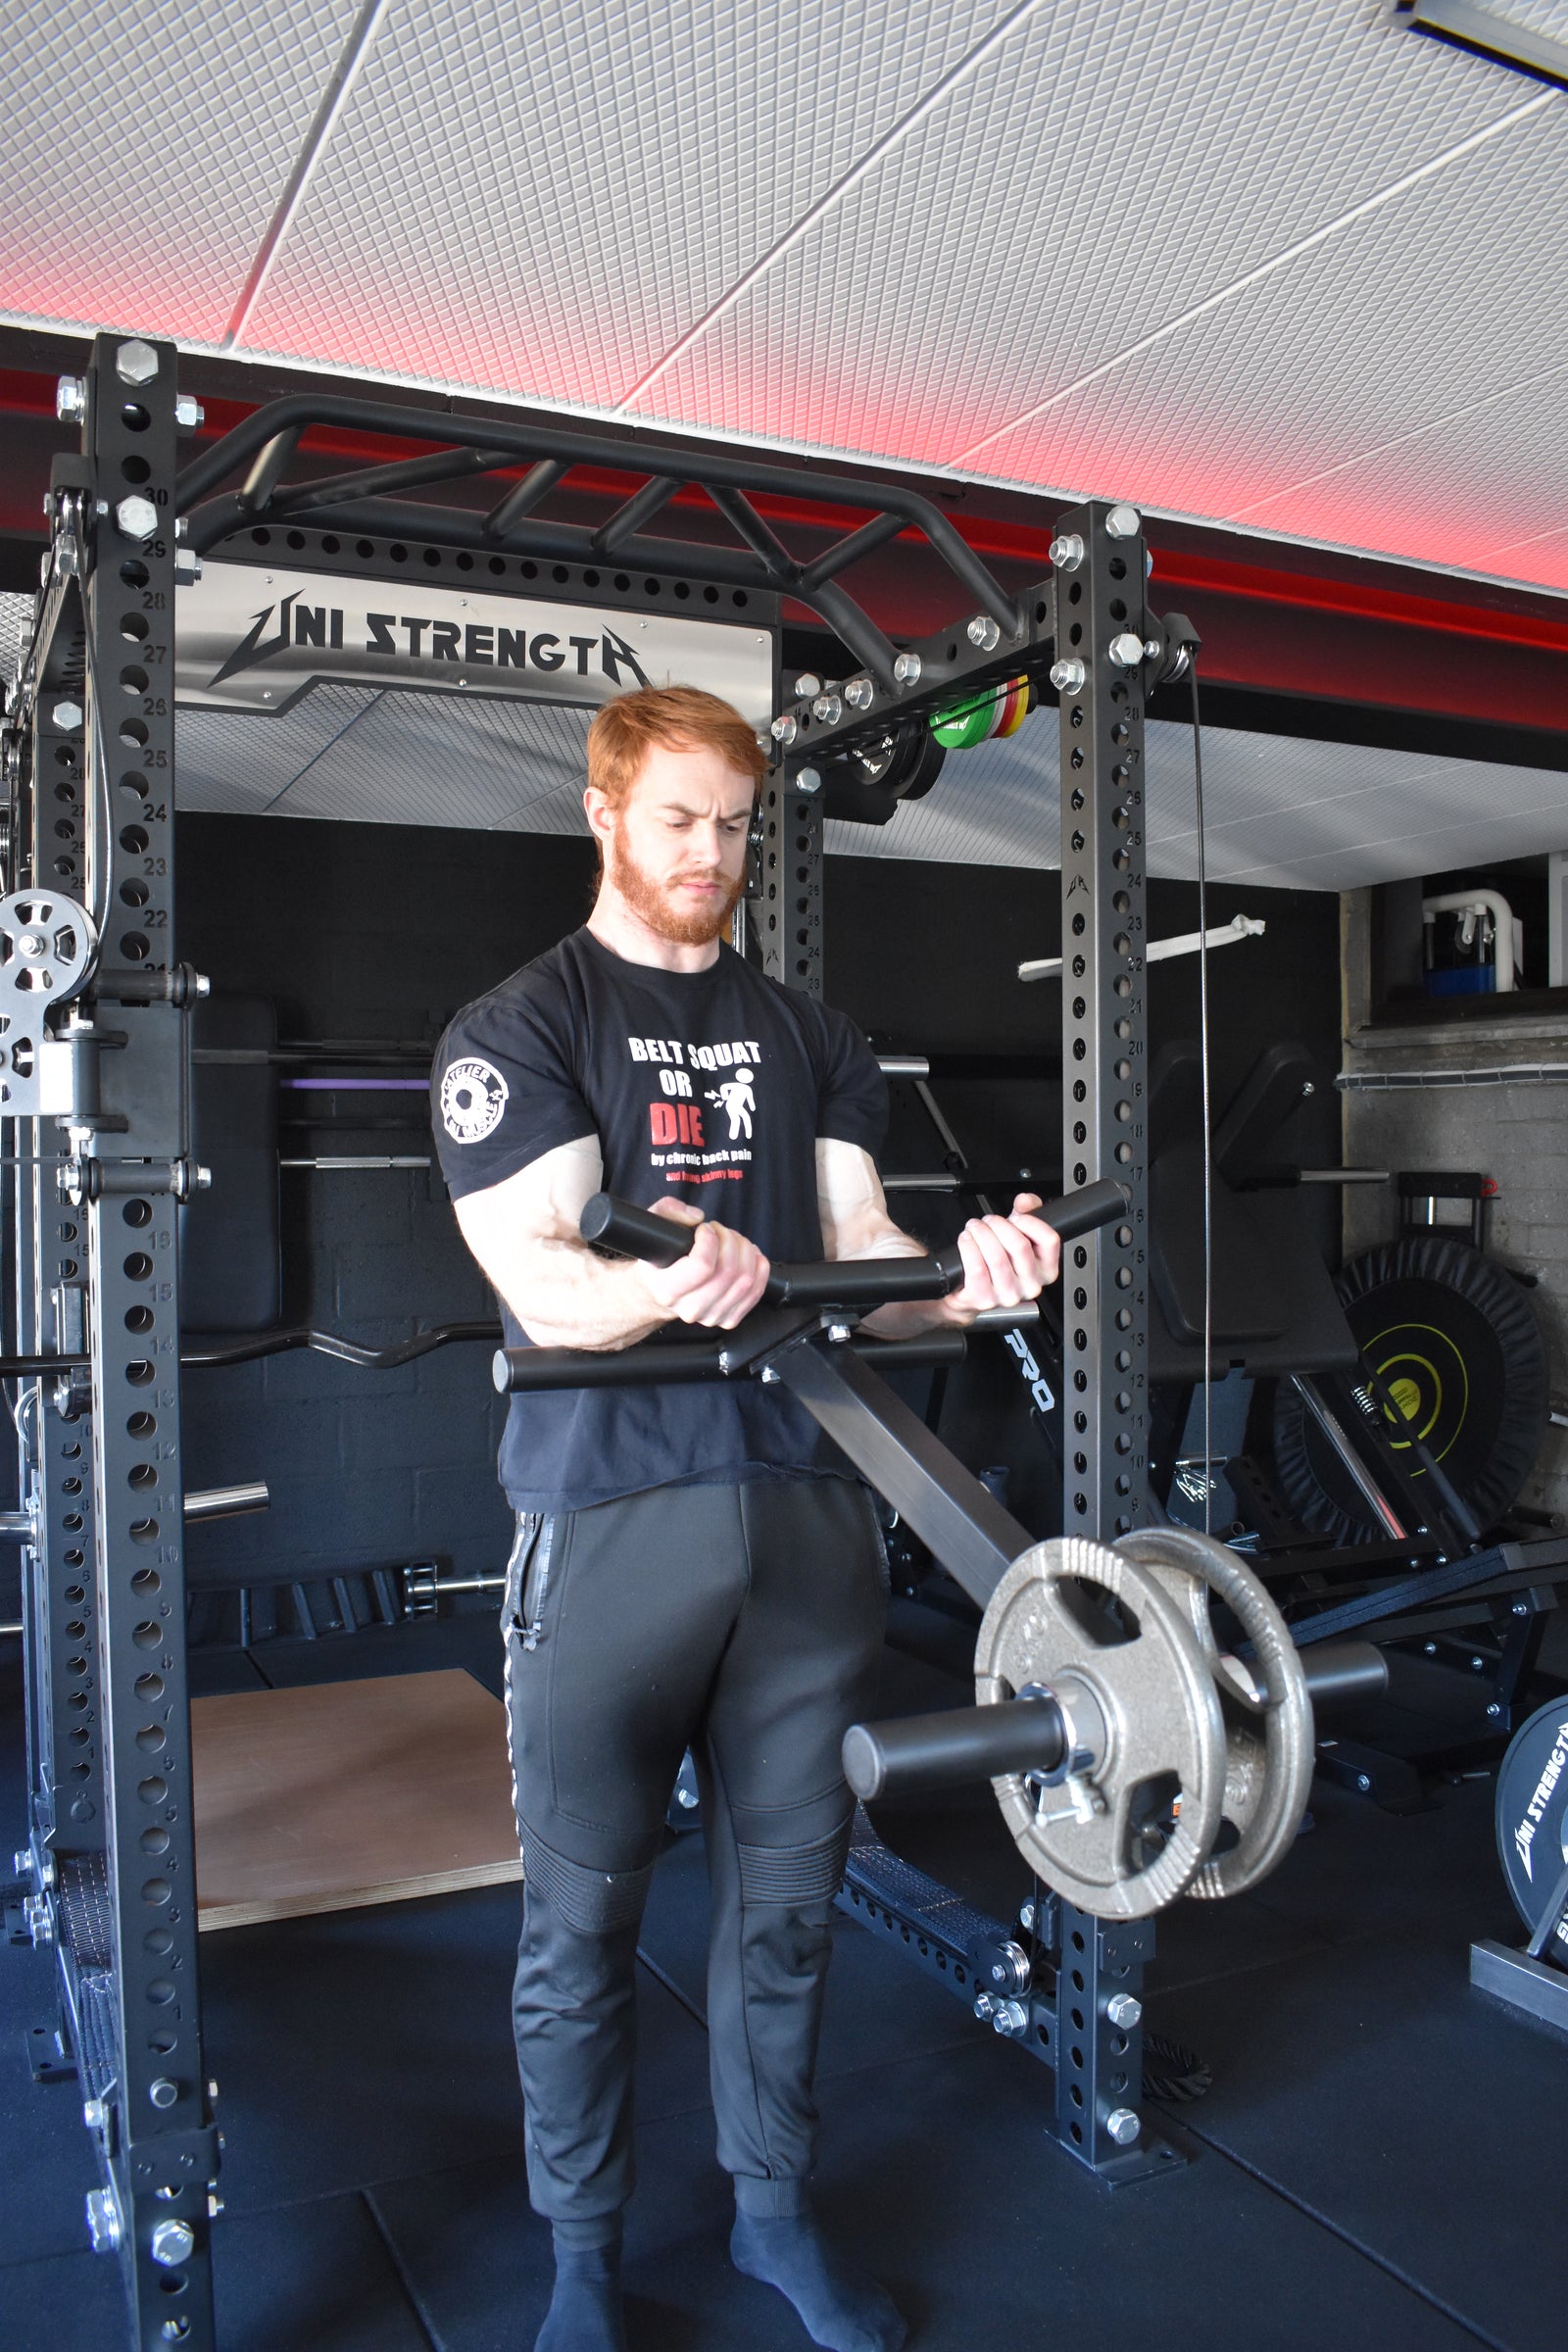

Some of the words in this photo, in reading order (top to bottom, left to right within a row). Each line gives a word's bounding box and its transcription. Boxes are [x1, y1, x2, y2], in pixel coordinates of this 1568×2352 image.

[208, 589, 343, 687] UNI
[367, 613, 652, 688] STRENGTH
[143, 645, 167, 663] 27
[143, 749, 168, 768] 25
[1125, 749, 1141, 764] 27
[143, 804, 167, 822] 24
[144, 858, 167, 877] 23
[808, 854, 819, 865] 27
[1127, 872, 1142, 888] 24
[144, 909, 168, 928] 22
[1128, 915, 1143, 931] 23
[808, 947, 820, 957] 24
[1127, 956, 1143, 971] 22
[628, 1037, 684, 1064] BELT
[687, 1041, 761, 1071] SQUAT
[1128, 1041, 1144, 1055] 20
[659, 1068, 693, 1098] OR
[649, 1102, 705, 1147] DIE
[651, 1152, 664, 1166] by
[666, 1152, 701, 1166] chronic
[702, 1150, 730, 1165] back
[731, 1149, 753, 1162] pain
[1130, 1250, 1145, 1264] 15
[1130, 1333, 1145, 1348] 13
[1004, 1328, 1055, 1412] PRO
[1130, 1373, 1145, 1388] 12
[86, 1710, 95, 1723] 2
